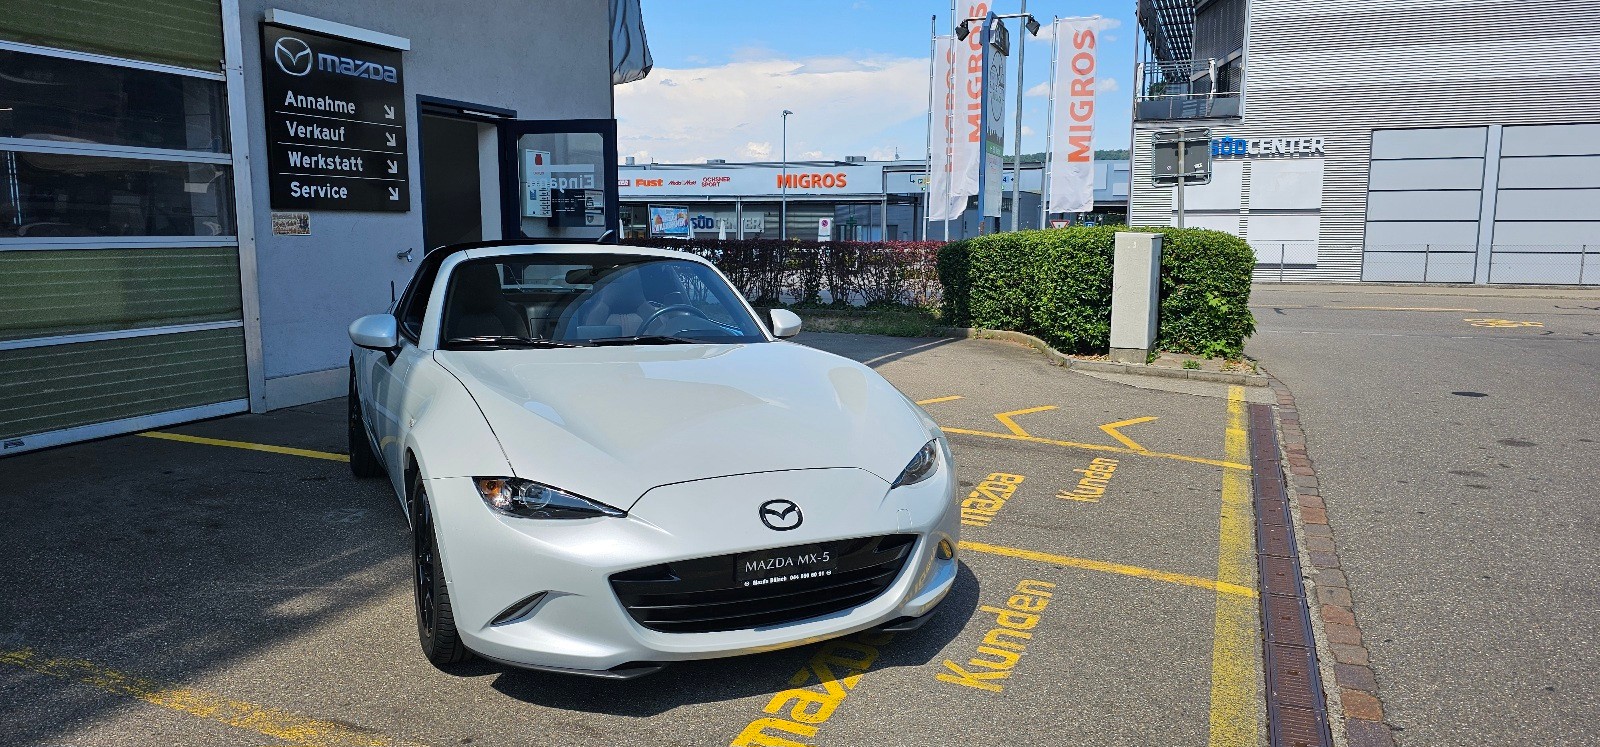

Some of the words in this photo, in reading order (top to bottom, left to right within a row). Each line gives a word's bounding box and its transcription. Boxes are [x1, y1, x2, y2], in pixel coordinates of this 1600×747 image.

[317, 53, 397, 84] mazda
[966, 2, 989, 143] MIGROS
[284, 90, 356, 114] Annahme
[1067, 29, 1096, 163] MIGROS
[285, 120, 345, 142] Verkauf
[287, 150, 364, 172] Werkstatt
[290, 181, 348, 199] Service
[635, 178, 663, 187] Fust
[777, 172, 847, 189] MIGROS
[1055, 456, 1120, 503] Kunden
[745, 556, 793, 573] MAZDA
[797, 552, 829, 565] MX-5
[935, 579, 1056, 693] Kunden
